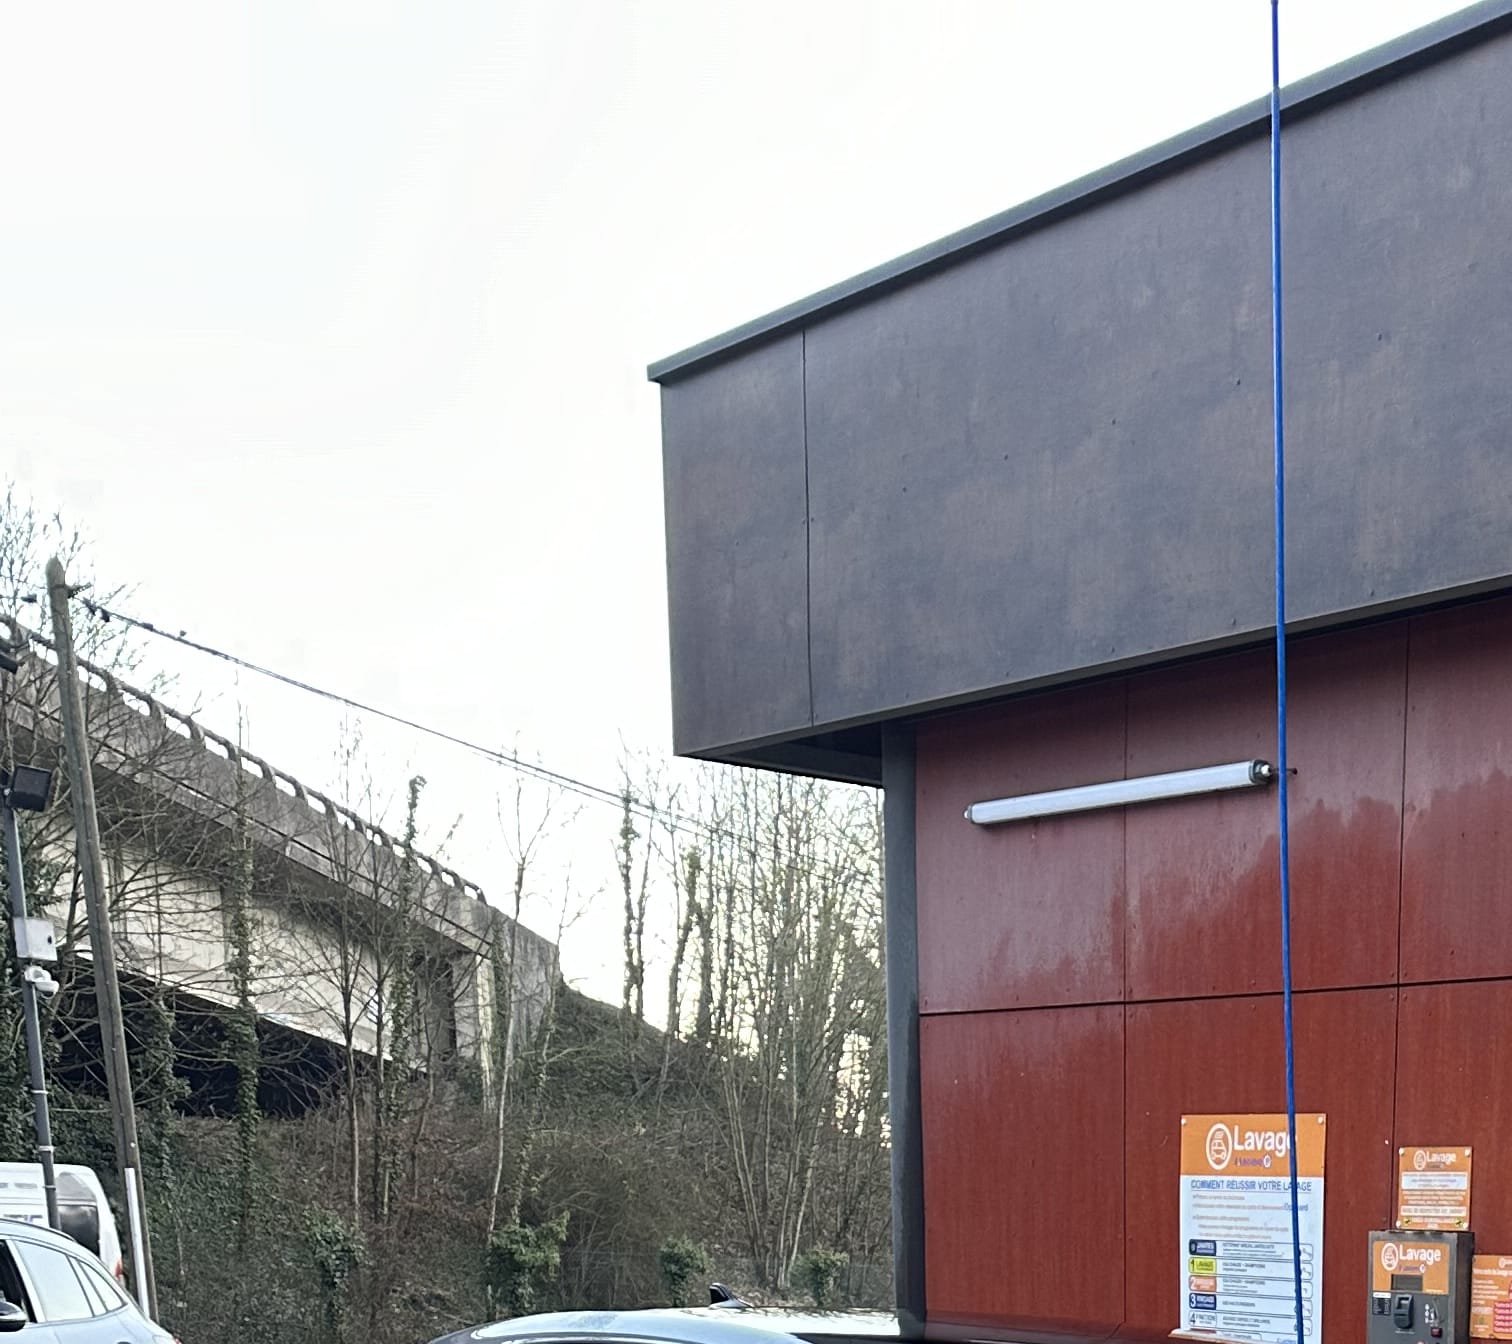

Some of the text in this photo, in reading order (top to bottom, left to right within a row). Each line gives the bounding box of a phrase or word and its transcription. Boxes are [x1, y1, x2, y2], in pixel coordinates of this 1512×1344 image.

[1258, 1180, 1281, 1191] VOTRE
[1283, 1181, 1312, 1192] LAAGE
[1400, 1244, 1441, 1265] Lavage
